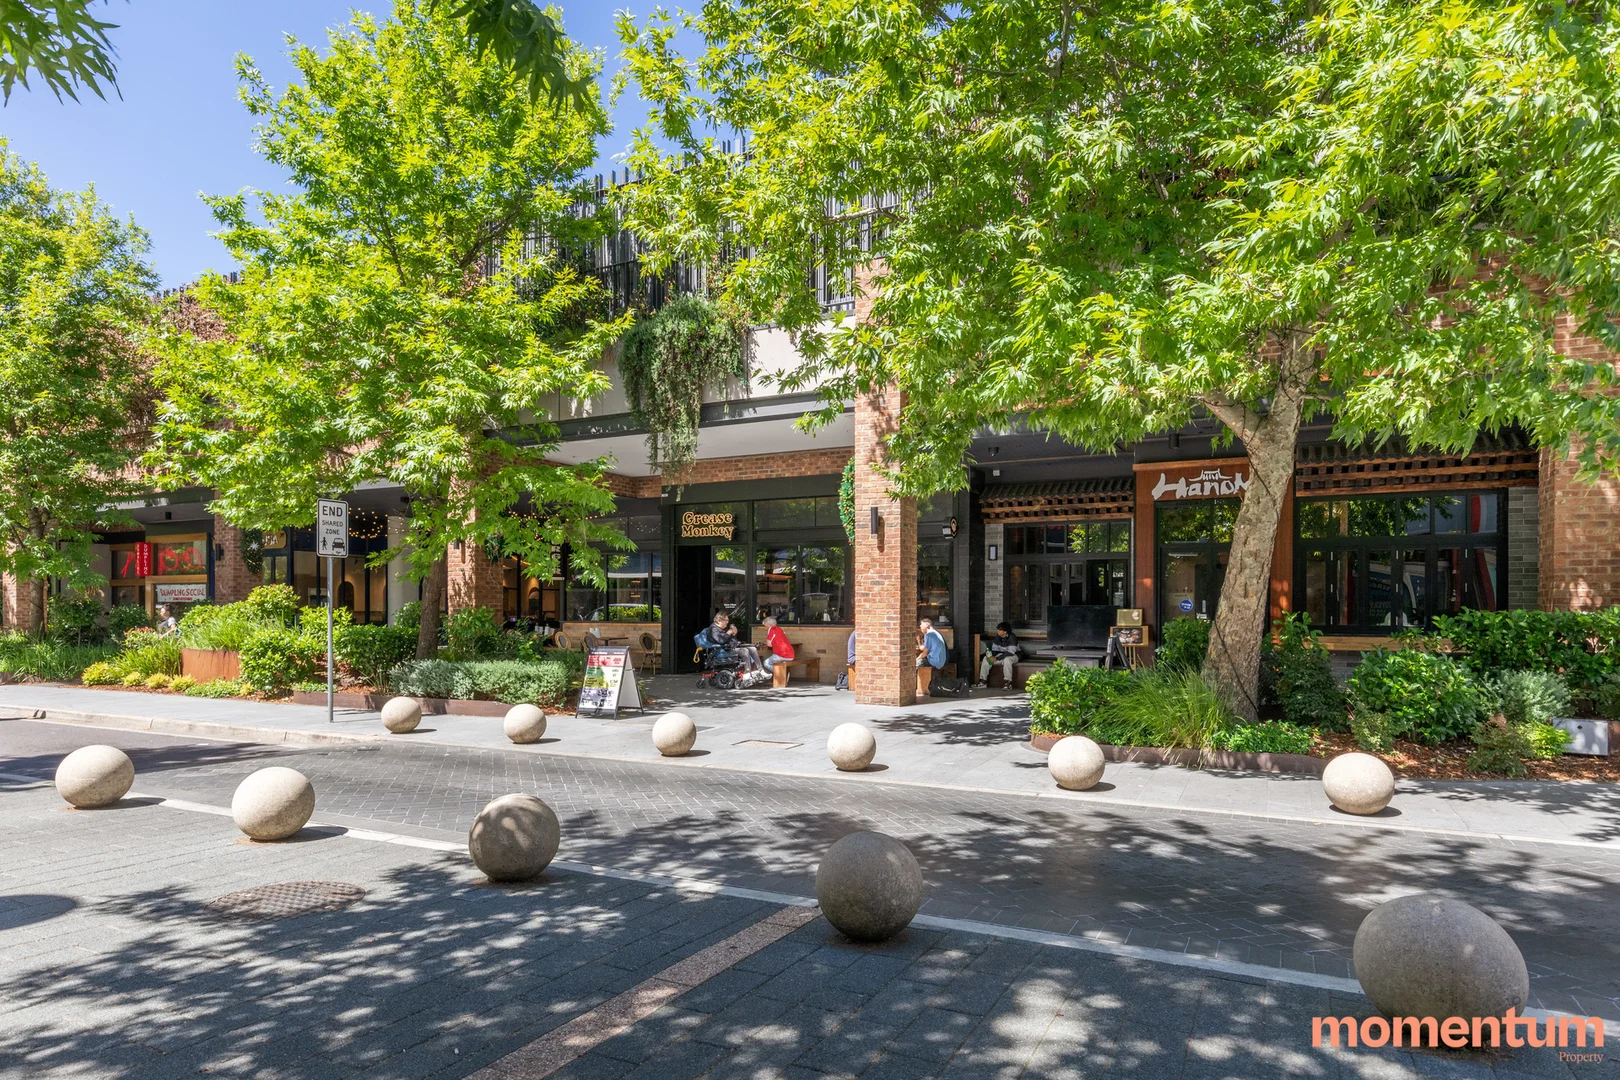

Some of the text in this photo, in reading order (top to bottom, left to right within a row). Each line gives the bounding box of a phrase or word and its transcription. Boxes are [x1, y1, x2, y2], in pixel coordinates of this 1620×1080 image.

[322, 505, 343, 517] END
[321, 519, 344, 528] SHARED
[682, 511, 733, 525] Grease
[325, 528, 340, 536] ZONE
[681, 524, 735, 541] Monkey
